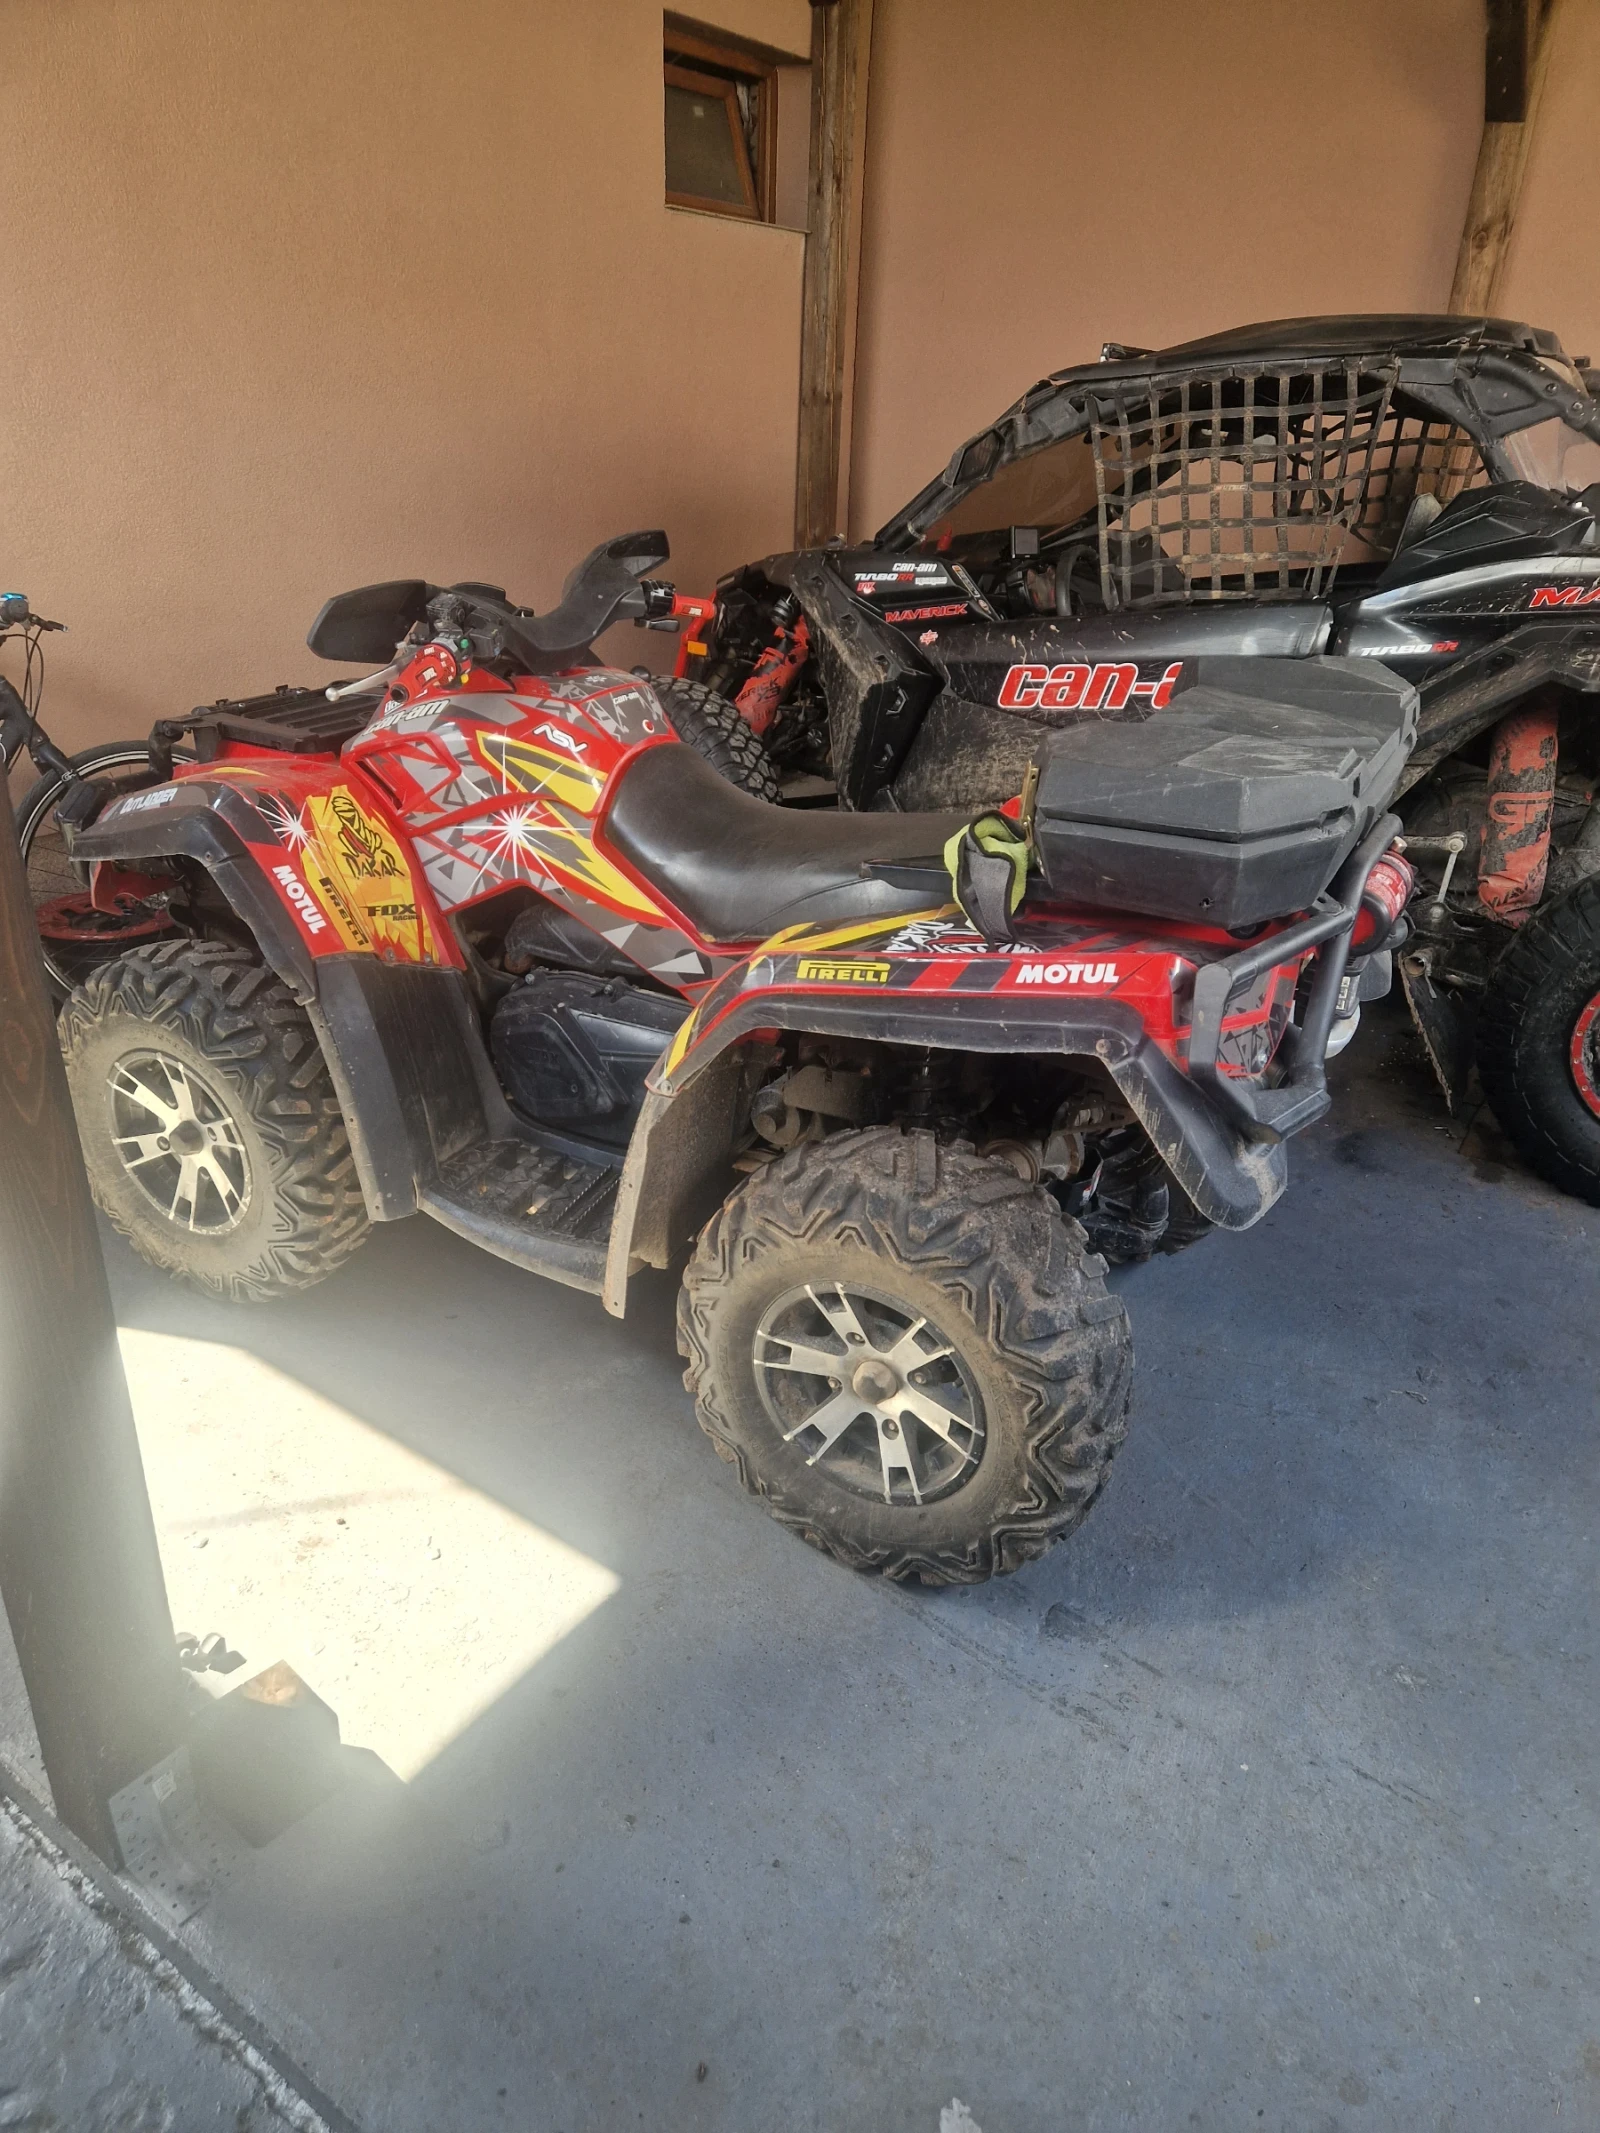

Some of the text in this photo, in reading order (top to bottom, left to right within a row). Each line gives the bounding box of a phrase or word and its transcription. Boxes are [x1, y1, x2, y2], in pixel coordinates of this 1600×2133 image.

[892, 562, 938, 573] can-am
[885, 603, 968, 623] MAVERICK
[361, 698, 451, 736] can-am
[120, 787, 178, 815] OUTLANDER
[341, 848, 405, 880] DAKAR
[272, 865, 327, 935] MOTUL
[318, 876, 369, 946] PIRELLI
[359, 903, 417, 917] FOX
[881, 920, 955, 954] DAKA
[796, 960, 891, 983] PIRELLI
[1015, 963, 1120, 984] MOTUL
